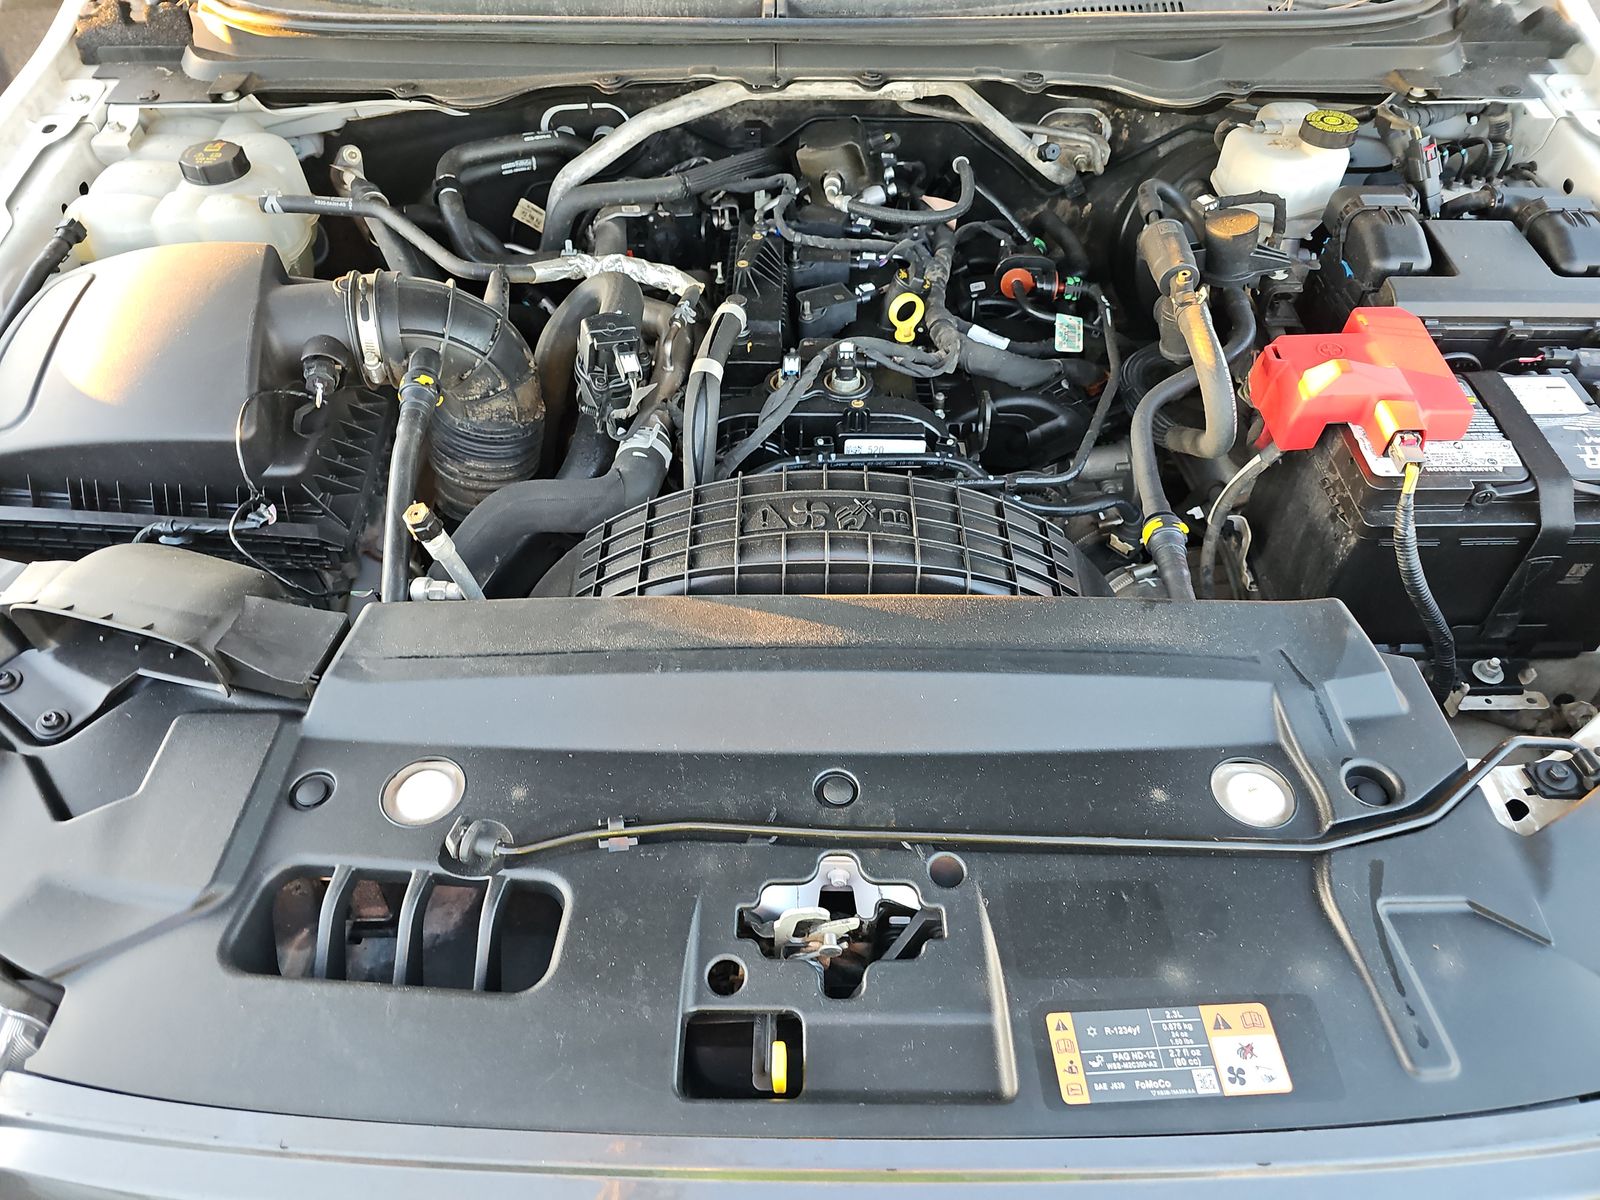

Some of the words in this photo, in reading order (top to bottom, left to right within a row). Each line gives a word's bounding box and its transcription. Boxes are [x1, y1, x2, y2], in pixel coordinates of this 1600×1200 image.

[1165, 1010, 1184, 1019] 2.3L
[1104, 1025, 1141, 1036] R-1234yf
[1183, 1022, 1193, 1032] kg
[1112, 1052, 1130, 1061] PAG
[1131, 1050, 1156, 1061] ND-12
[1169, 1048, 1181, 1058] 2.7
[1183, 1048, 1190, 1057] fl
[1190, 1049, 1202, 1057] oz
[1188, 1056, 1202, 1066] cc)
[1134, 1079, 1172, 1090] FoMoCo
